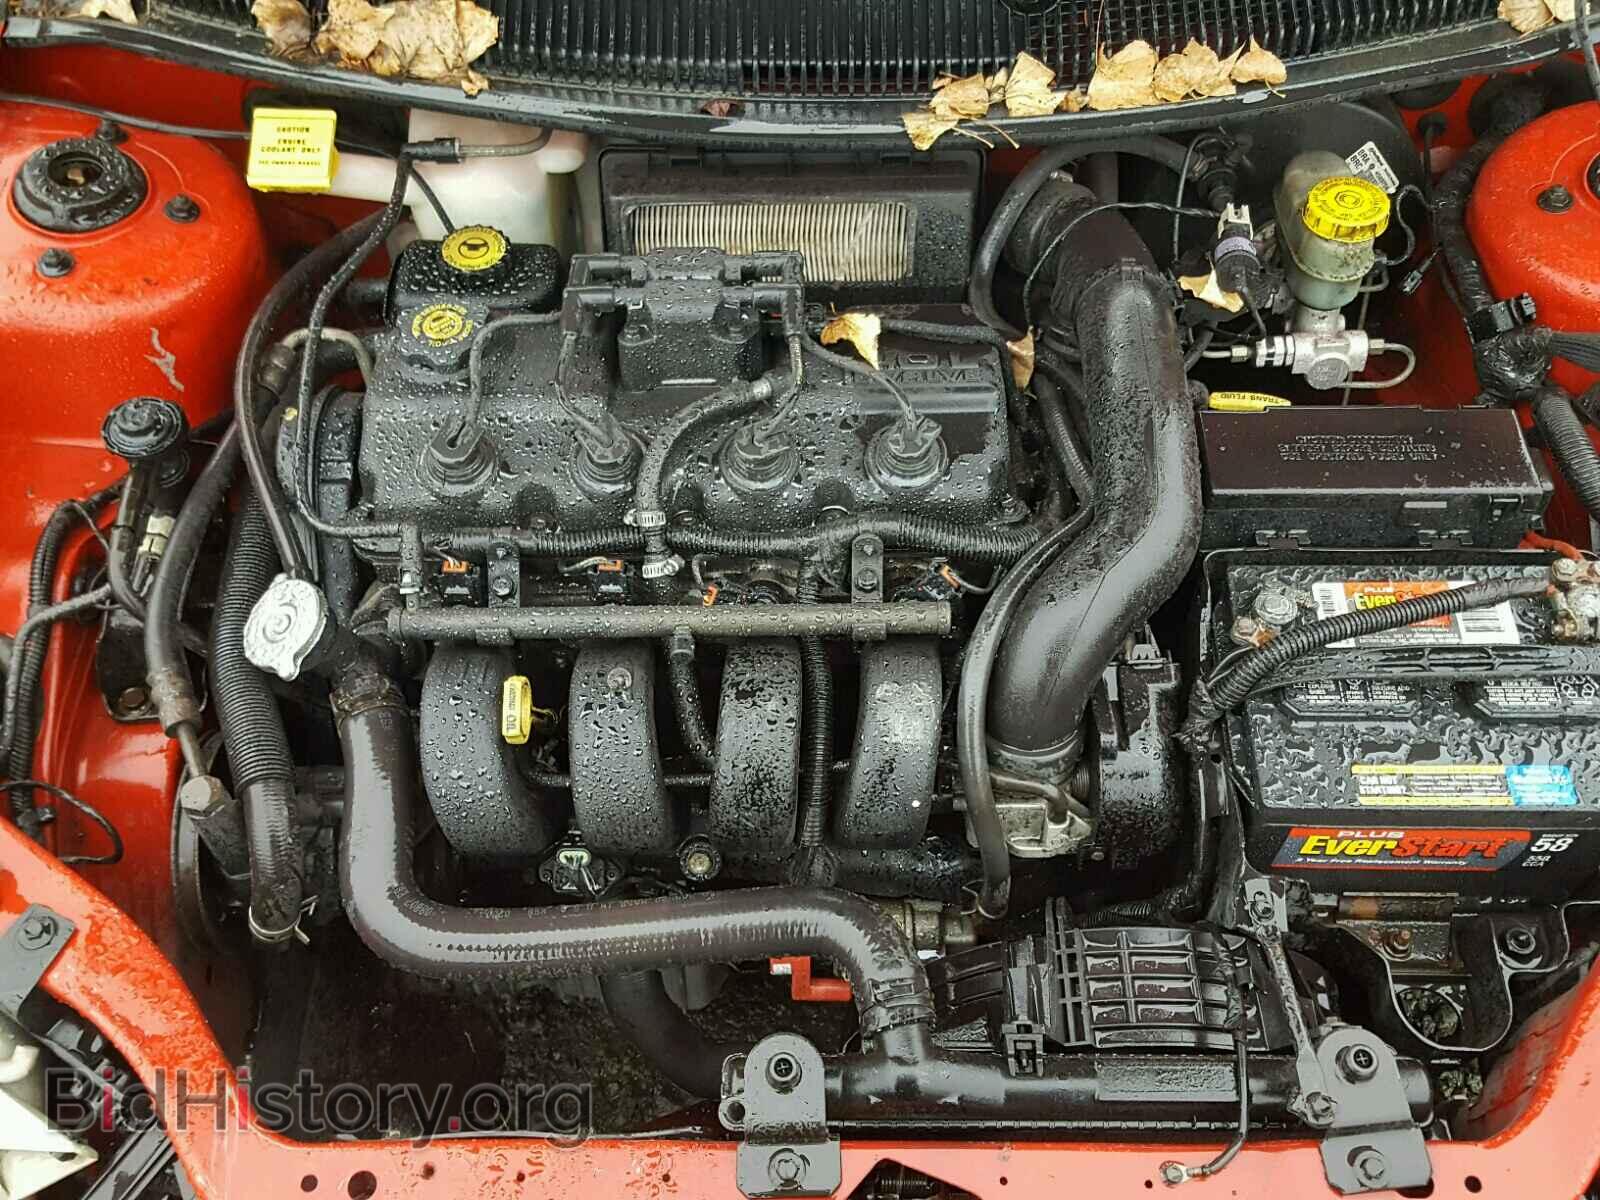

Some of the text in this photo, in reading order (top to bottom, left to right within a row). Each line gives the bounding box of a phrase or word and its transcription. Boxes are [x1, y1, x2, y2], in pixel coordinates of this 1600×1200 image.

[1336, 830, 1406, 839] PLUS
[1300, 835, 1511, 858] EverStart
[1530, 837, 1575, 852] 58
